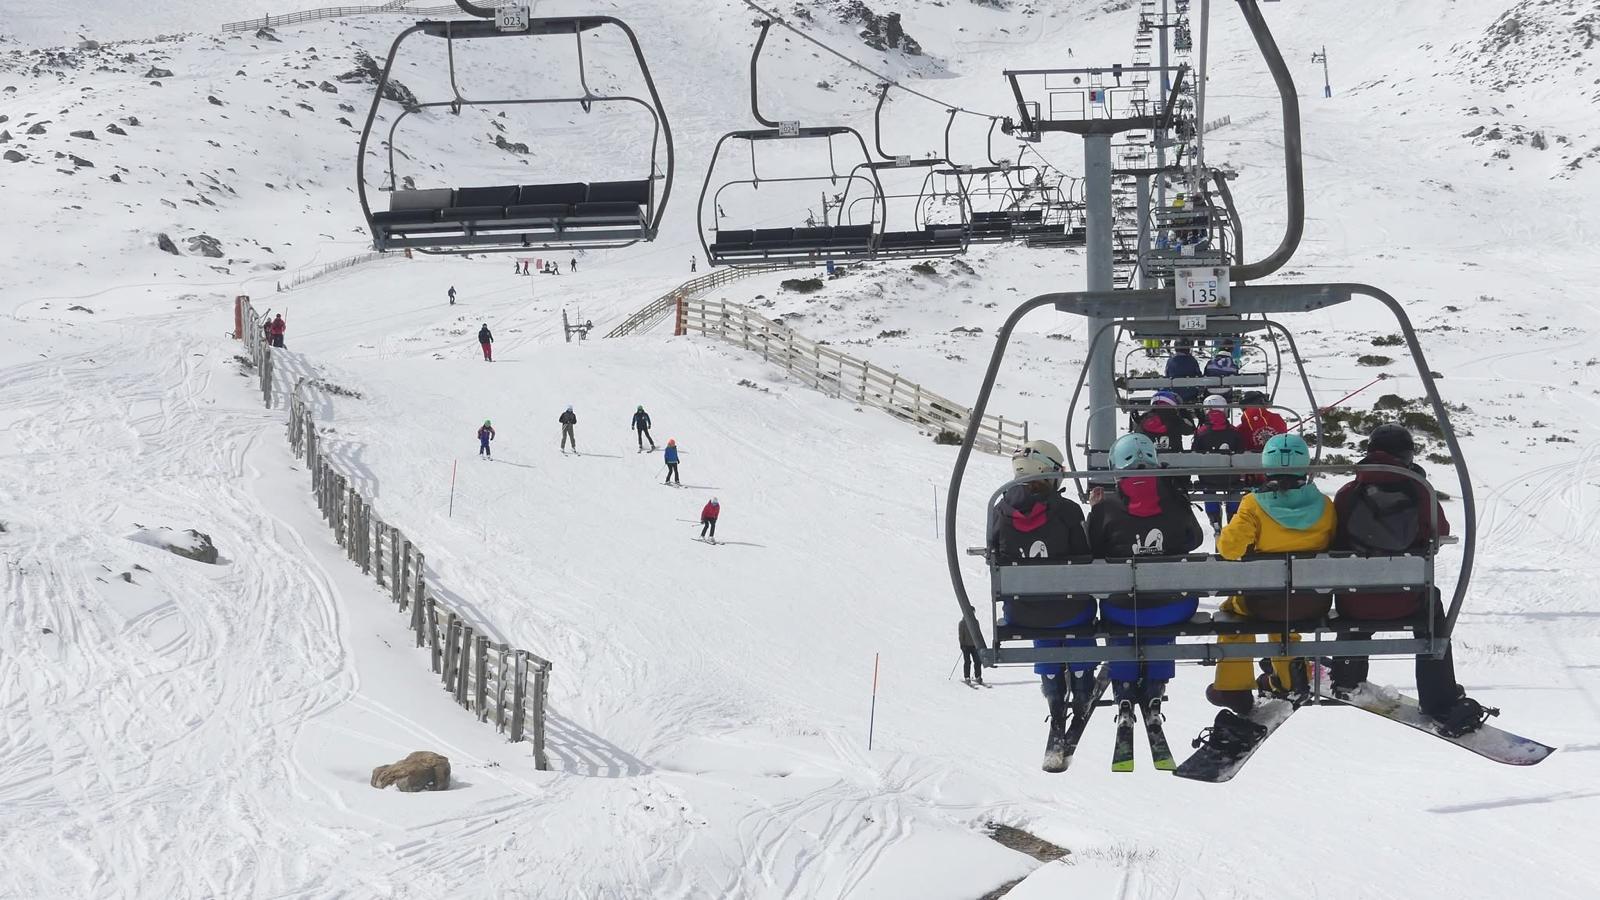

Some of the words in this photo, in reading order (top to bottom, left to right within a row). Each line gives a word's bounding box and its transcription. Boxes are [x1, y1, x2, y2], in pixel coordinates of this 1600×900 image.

[503, 17, 521, 26] 023
[1191, 289, 1217, 303] 135
[1187, 320, 1200, 328] 134
